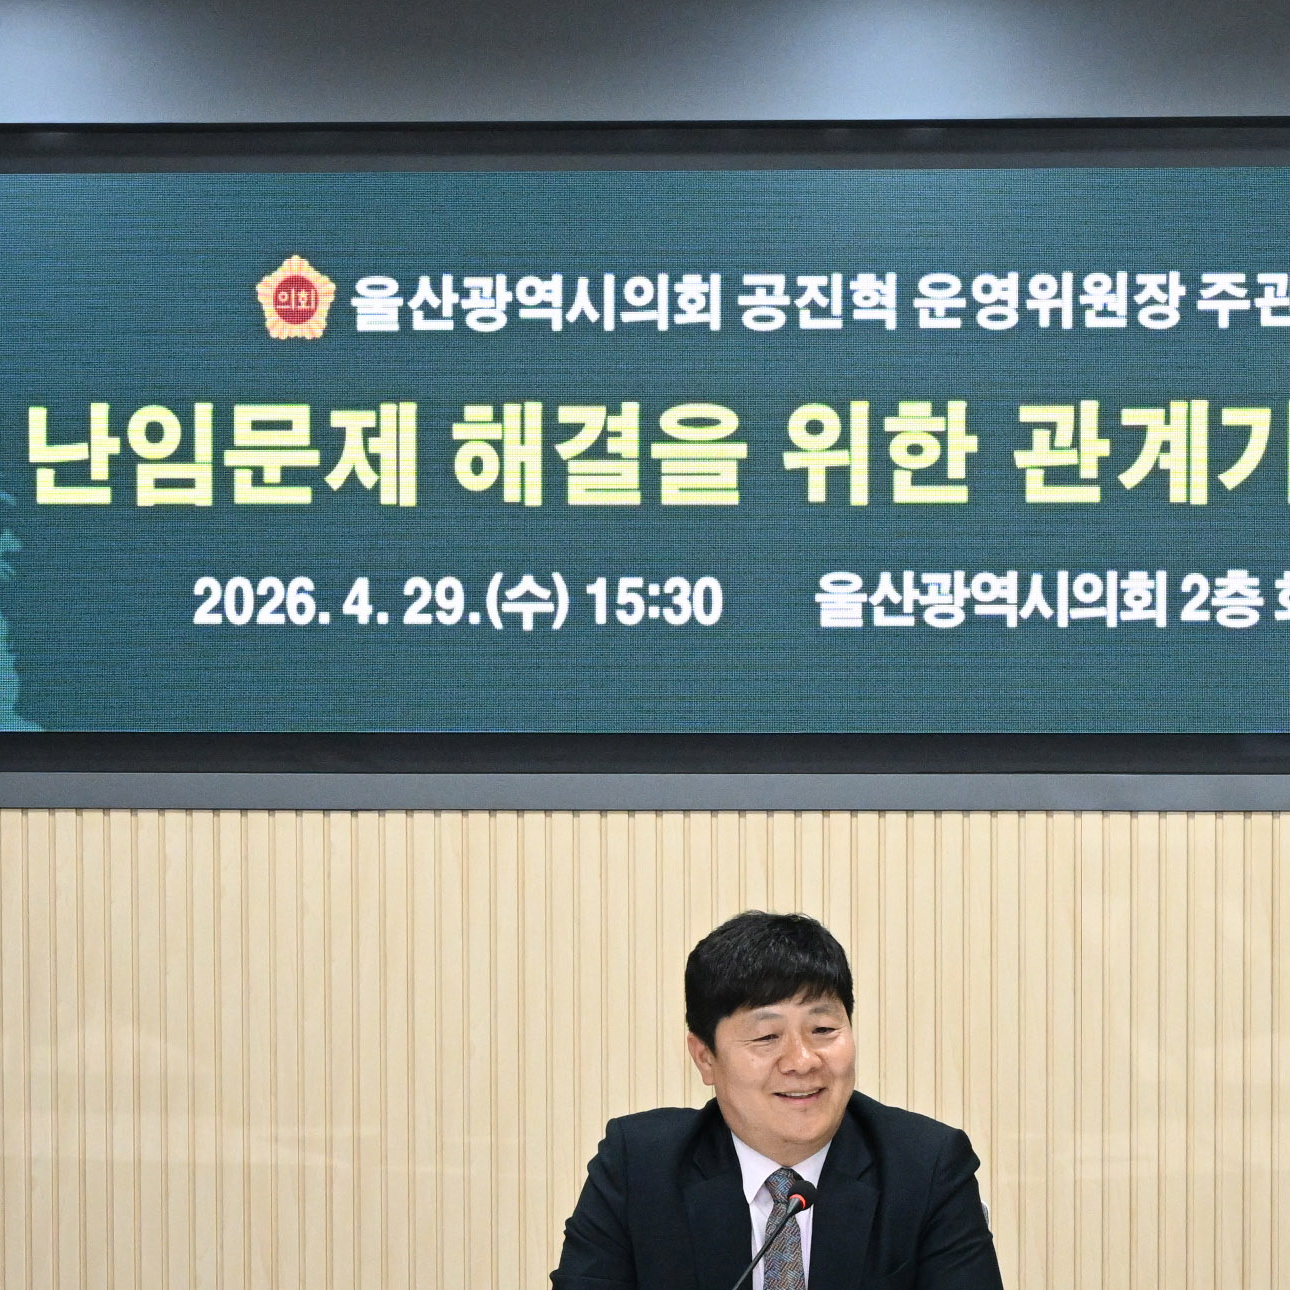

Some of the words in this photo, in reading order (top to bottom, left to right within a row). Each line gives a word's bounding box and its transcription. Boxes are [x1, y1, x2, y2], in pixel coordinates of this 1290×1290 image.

[276, 288, 317, 311] 의회
[351, 272, 721, 332] 울산광역시의회
[738, 271, 897, 331] 공진혁
[913, 270, 1186, 330] 운영위원장
[28, 401, 418, 507] 난임문제
[451, 401, 748, 507] 해결을
[782, 400, 979, 506] 위한
[193, 576, 331, 626] 2026.
[343, 576, 389, 625] 4.
[403, 572, 570, 632] 29.(수)
[586, 576, 723, 627] 15:30
[814, 569, 1167, 629] 울산광역시의회
[1180, 568, 1265, 629] 2층
